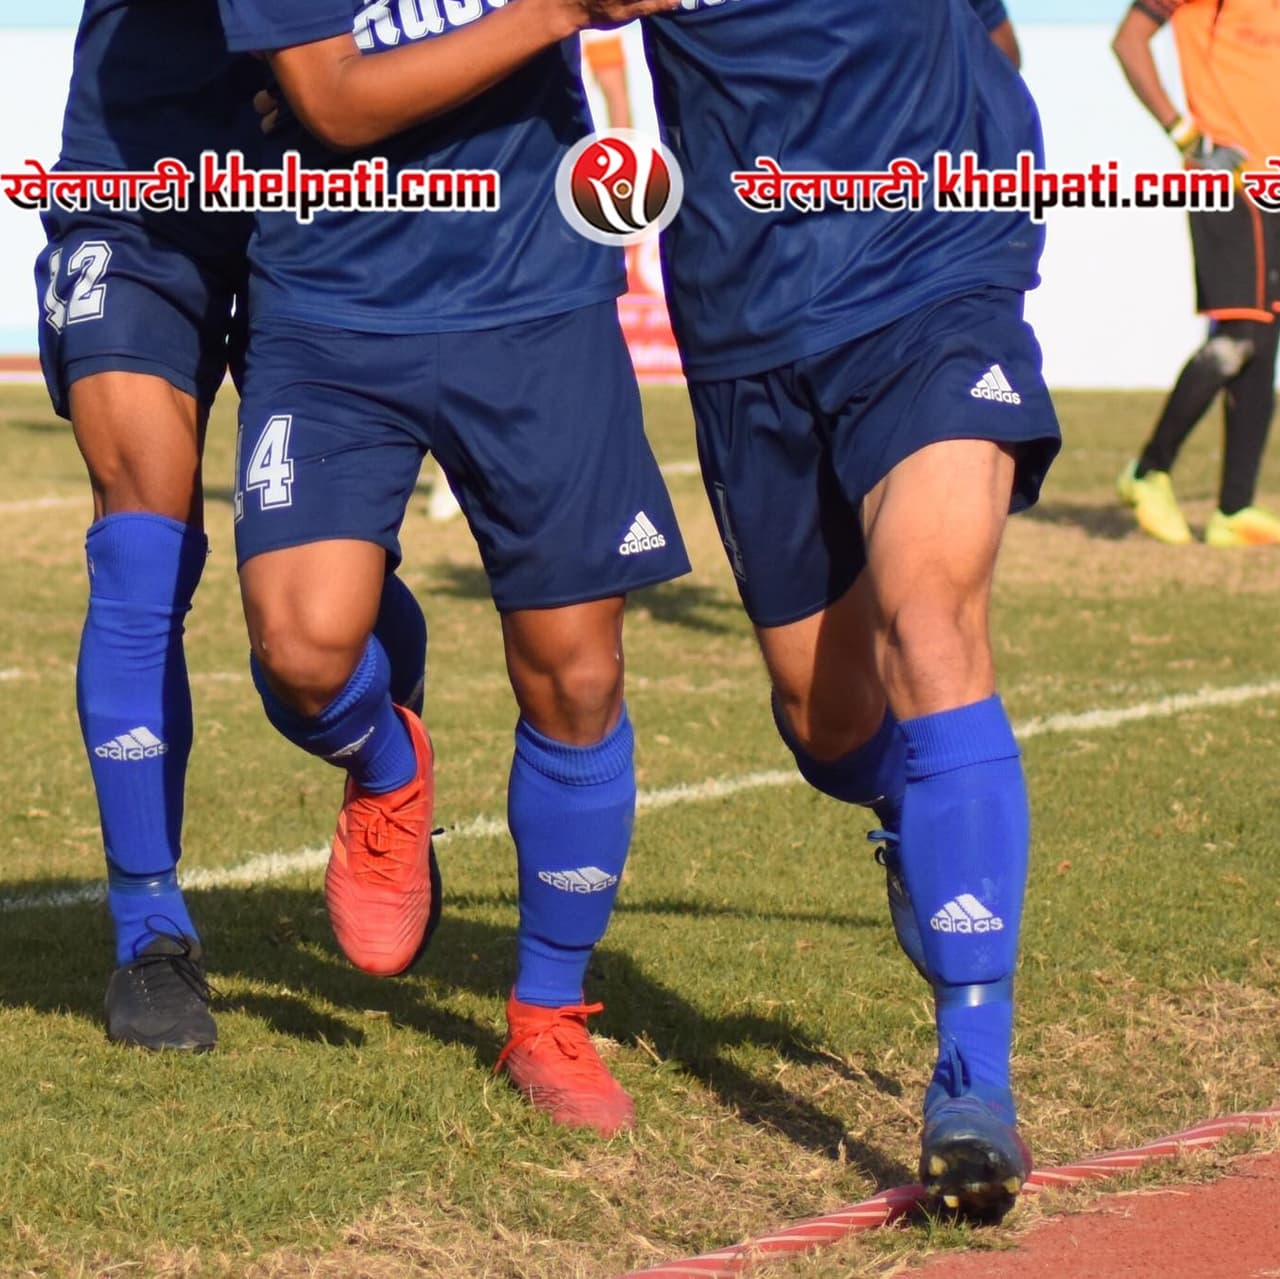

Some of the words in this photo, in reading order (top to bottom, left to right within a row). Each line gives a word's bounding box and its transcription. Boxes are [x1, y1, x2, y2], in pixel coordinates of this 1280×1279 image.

[43, 240, 113, 336] 12
[970, 386, 1022, 406] adidas
[234, 414, 295, 524] 4
[618, 533, 667, 556] adidas
[94, 742, 169, 761] adidas
[537, 871, 618, 895] adidas
[929, 916, 1005, 934] adidas
